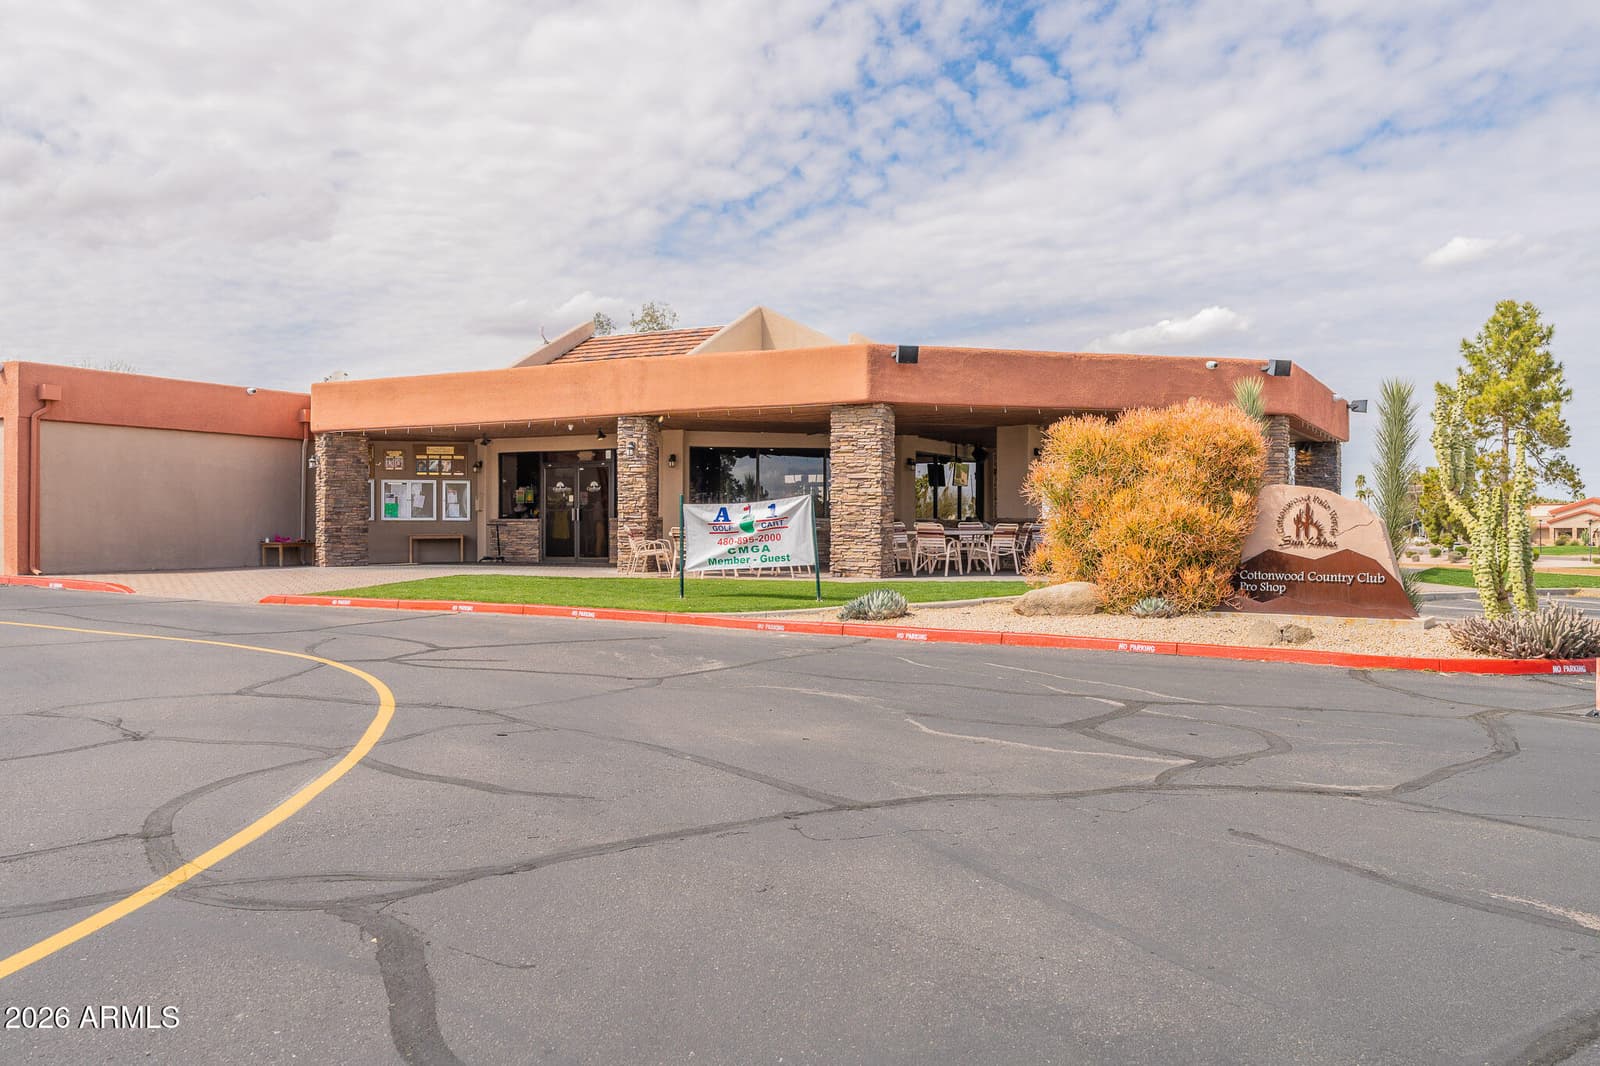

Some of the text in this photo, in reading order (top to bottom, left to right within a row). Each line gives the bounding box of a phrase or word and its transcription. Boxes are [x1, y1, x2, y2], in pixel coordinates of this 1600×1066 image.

[713, 503, 778, 522] A 1
[761, 520, 784, 529] CART
[717, 533, 782, 546] 480-895-2000
[1278, 535, 1337, 548] Sun Lakes
[728, 545, 770, 554] CMGA
[708, 555, 750, 566] Member
[760, 553, 790, 563] Guest
[1239, 570, 1386, 585] Cottonwood Country Club
[1240, 582, 1287, 594] Pro Shop
[1130, 644, 1156, 652] PARKING
[1553, 665, 1561, 673] NO
